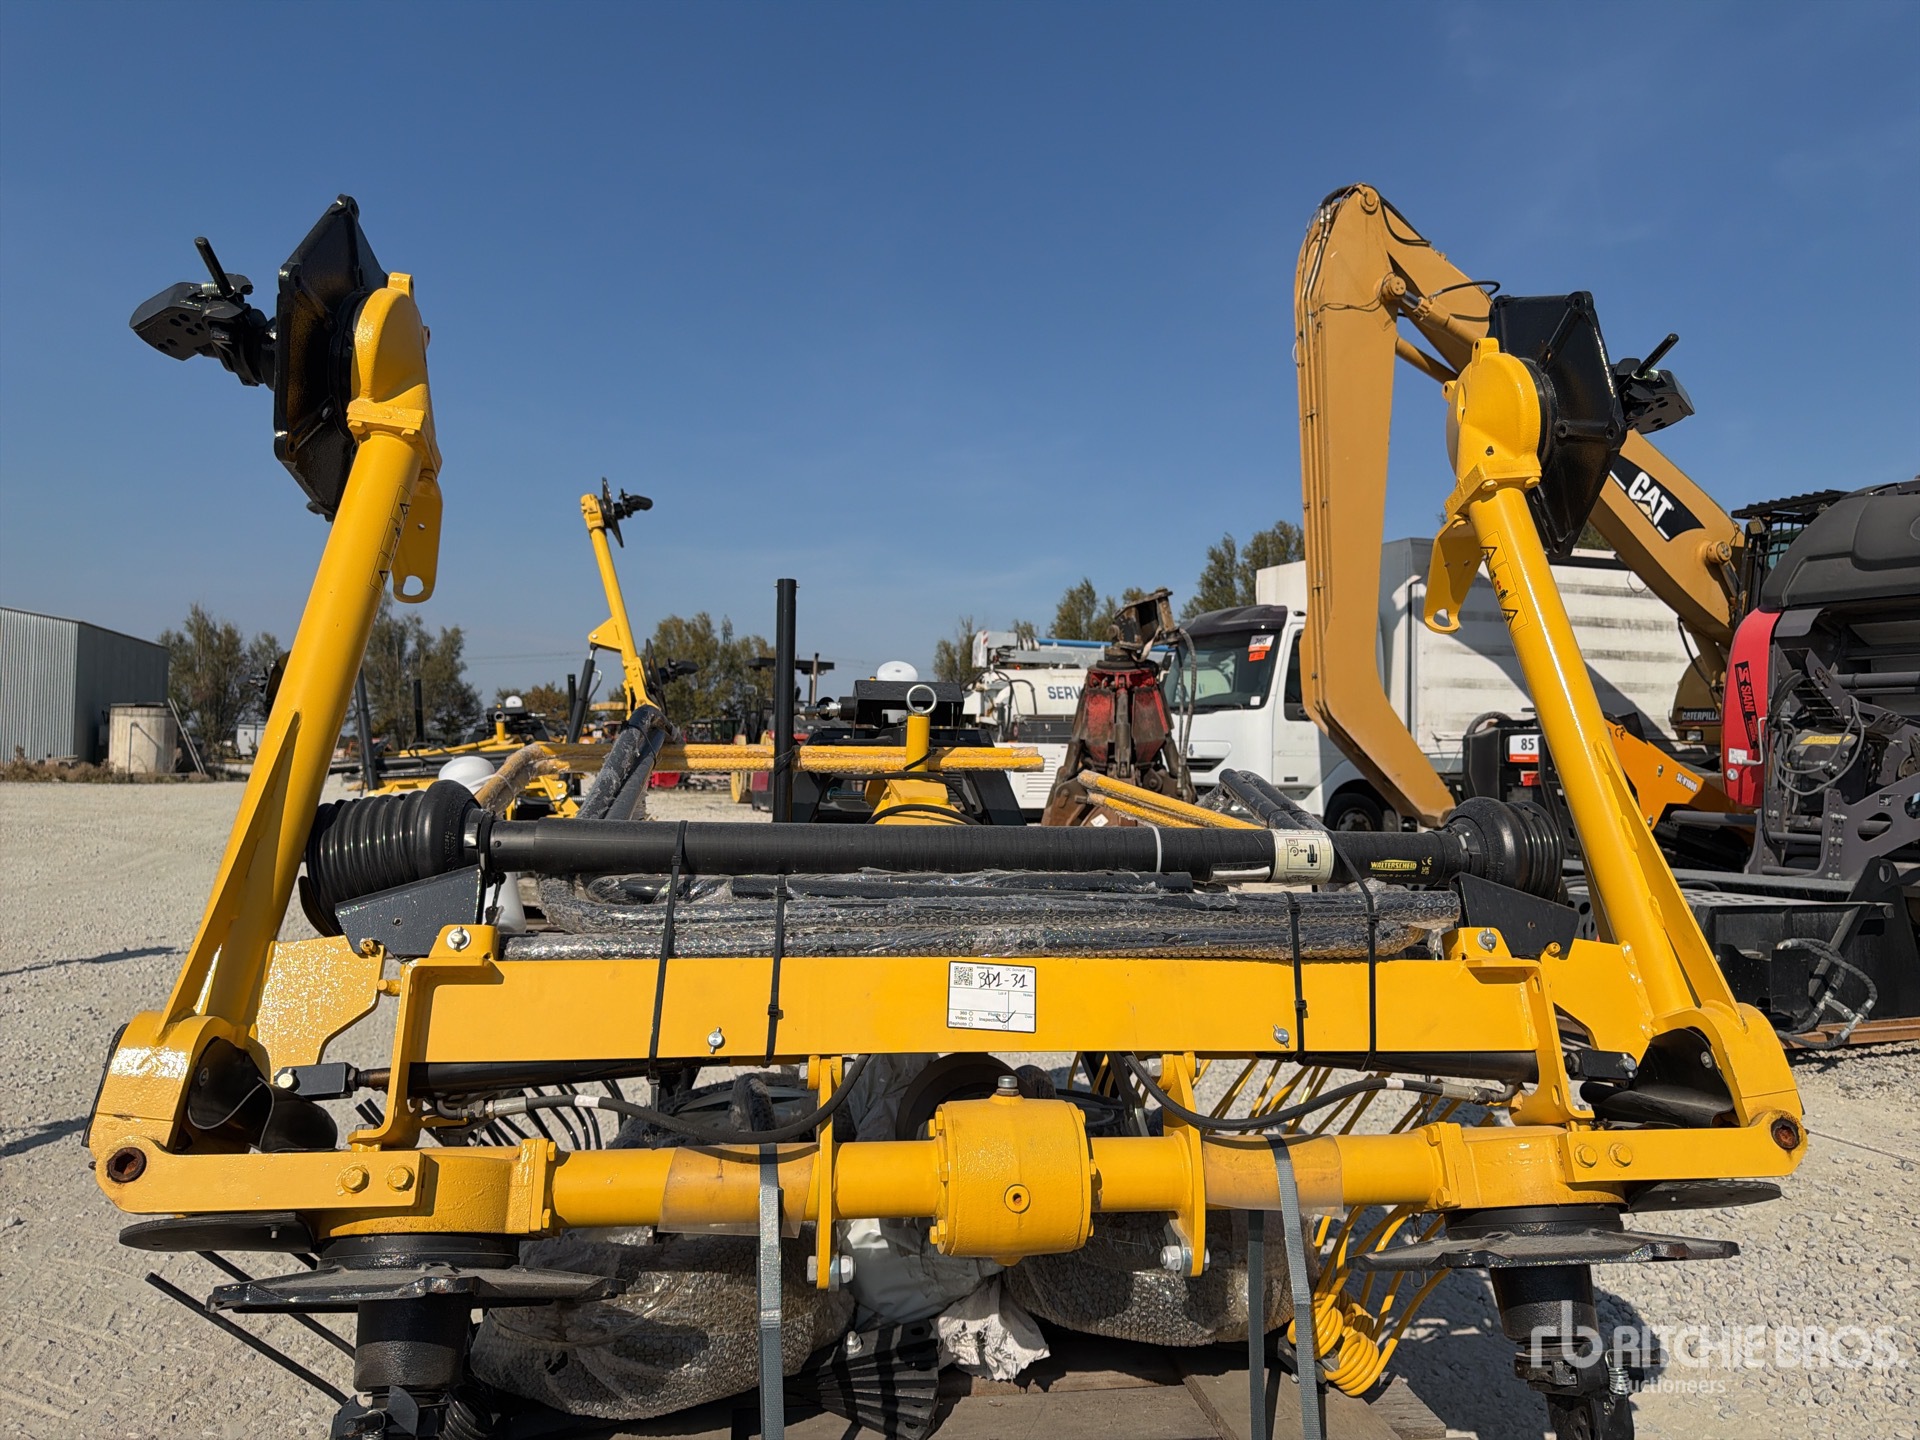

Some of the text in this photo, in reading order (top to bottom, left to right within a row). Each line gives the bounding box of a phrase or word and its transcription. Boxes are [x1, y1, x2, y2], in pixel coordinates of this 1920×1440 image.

[1628, 471, 1673, 526] CAT
[1741, 685, 1755, 712] SIANI
[1682, 711, 1720, 720] CATERPILLA
[1521, 738, 1535, 750] 85
[1370, 861, 1417, 869] WALTERSCHEID
